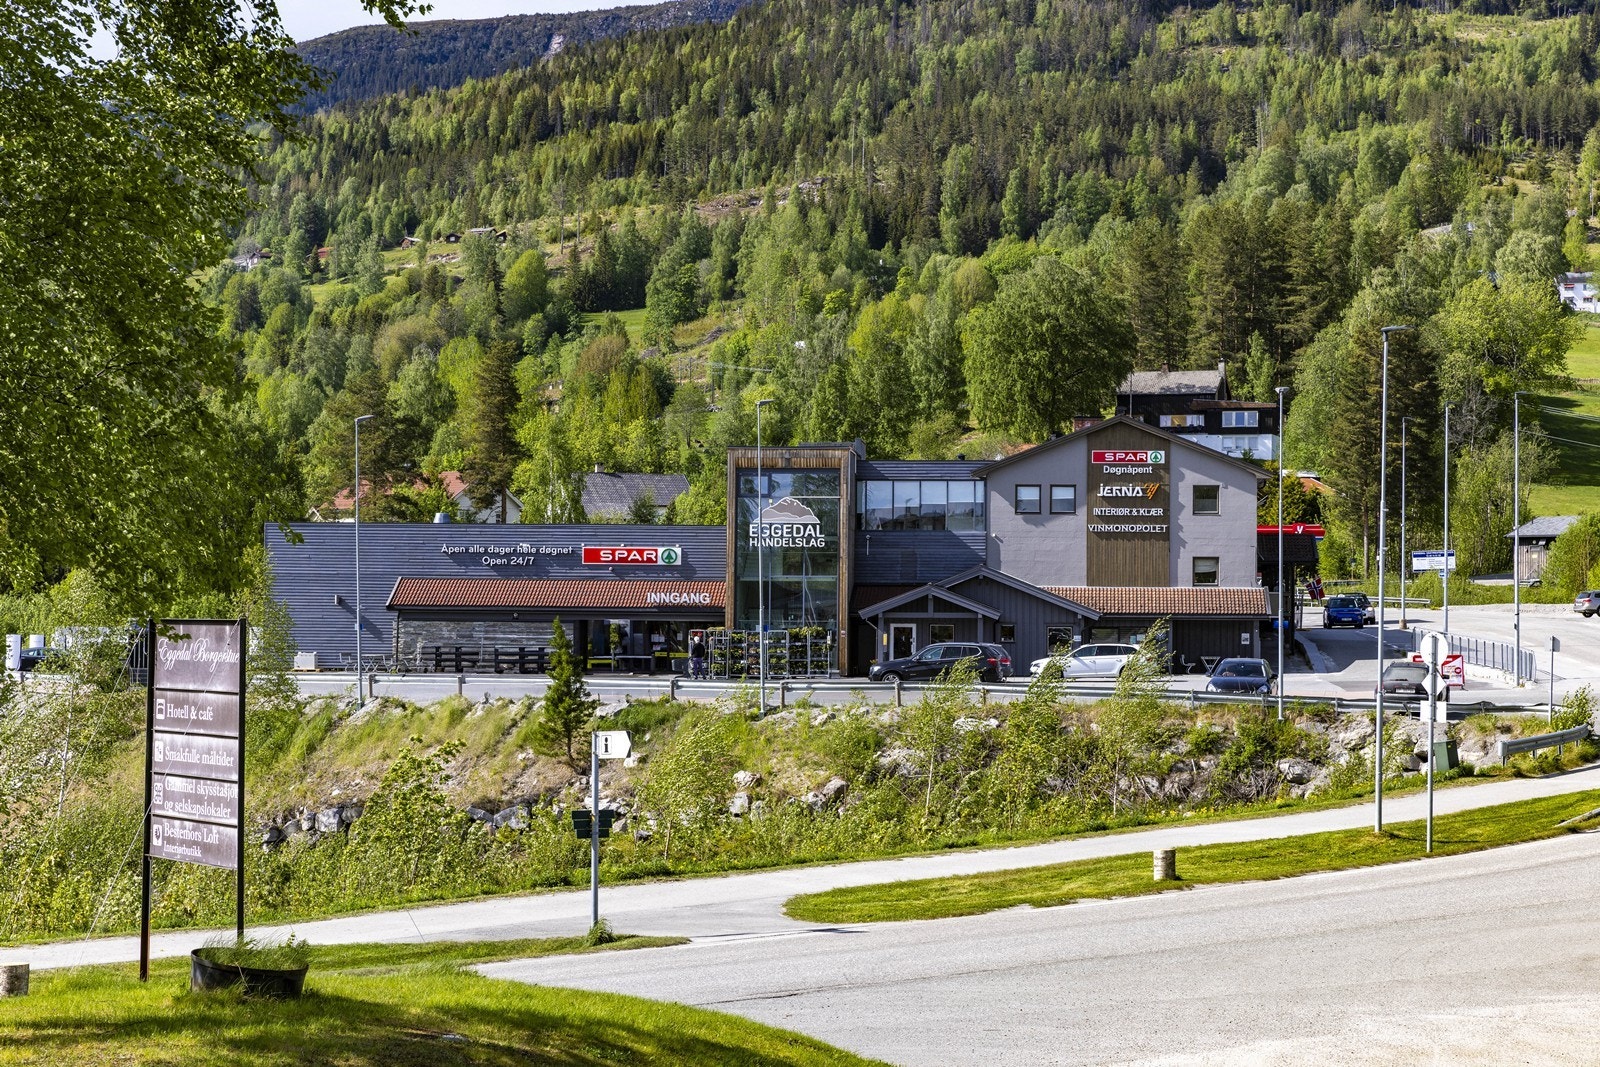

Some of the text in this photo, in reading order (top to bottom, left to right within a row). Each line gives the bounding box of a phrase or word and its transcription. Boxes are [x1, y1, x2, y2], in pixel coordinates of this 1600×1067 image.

[1105, 453, 1147, 461] SPAR
[1103, 465, 1153, 475] Døgnåpent
[1093, 508, 1164, 516] INTERIØR & KLÆR
[749, 524, 825, 538] EGGEDAL
[1088, 524, 1168, 533] VINMONOPOLET
[749, 538, 826, 547] HANDELSLAG
[440, 543, 573, 555] Åpen alle dager hele døgnet
[482, 556, 535, 566] Open 24/7
[600, 550, 657, 561] SPAR
[647, 592, 711, 604] INNGANG
[159, 638, 193, 670] Eggedal
[167, 704, 214, 720] Hotell & café
[165, 746, 235, 767] Smakfulle måltider
[165, 776, 196, 794] Gammel
[164, 799, 232, 818] og selskapslokaler
[164, 824, 219, 844] Bestemors Loft
